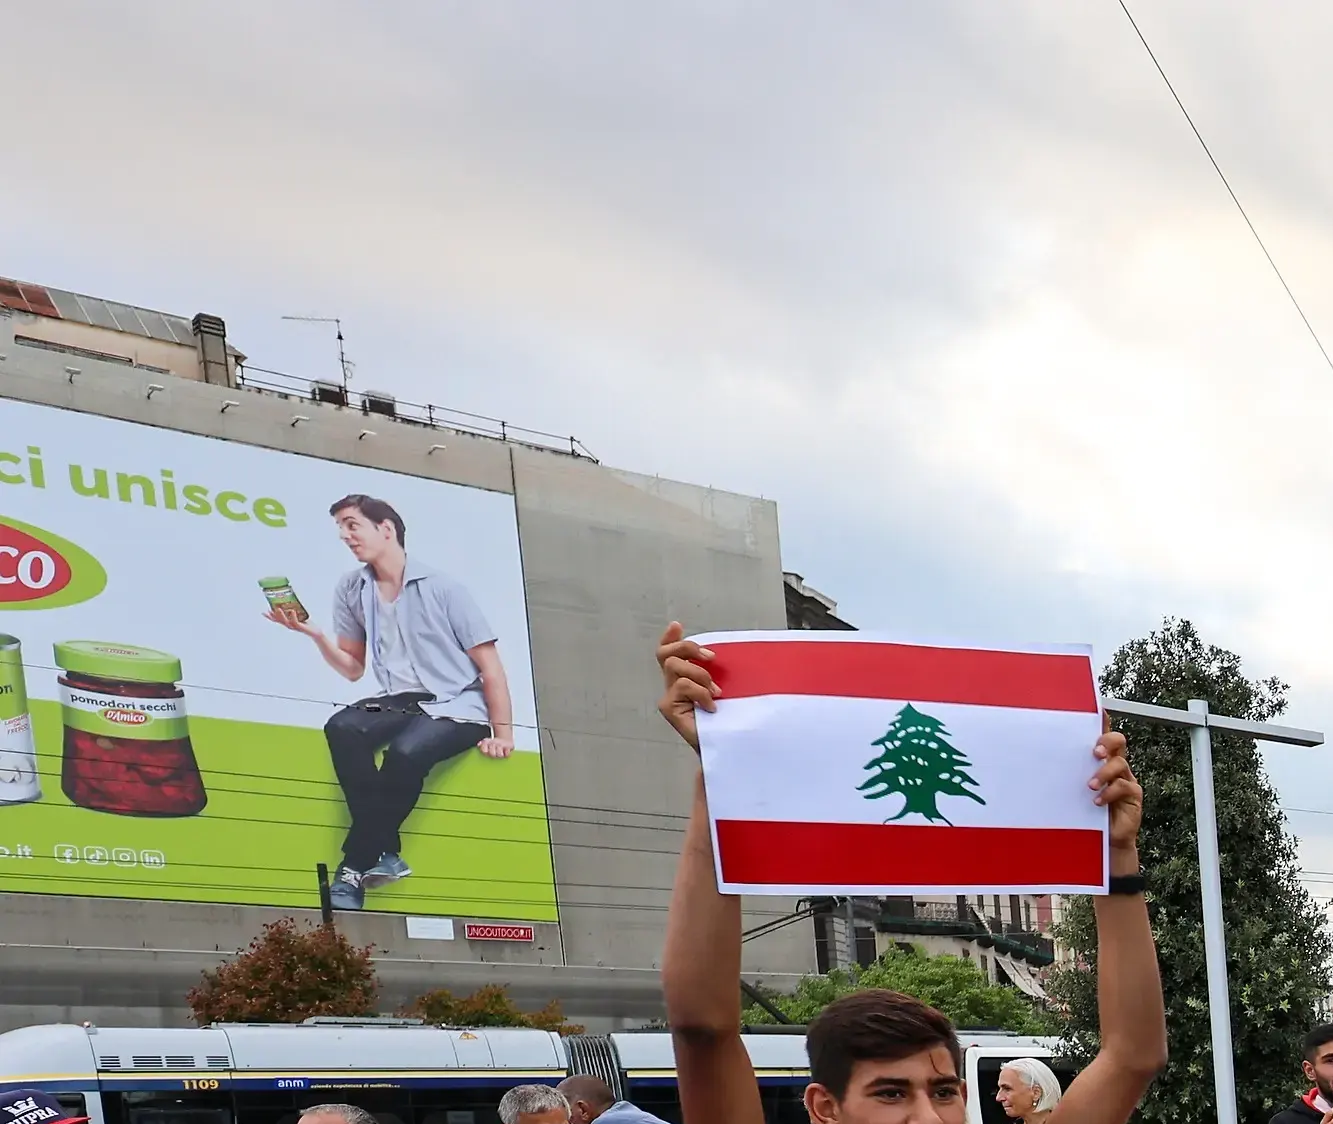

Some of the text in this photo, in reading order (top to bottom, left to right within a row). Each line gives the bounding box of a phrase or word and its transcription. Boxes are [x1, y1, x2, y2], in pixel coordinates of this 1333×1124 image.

[68, 463, 287, 528] unisce
[71, 693, 177, 712] pomodori secchi
[182, 1079, 219, 1090] 1109
[277, 1079, 304, 1088] anm
